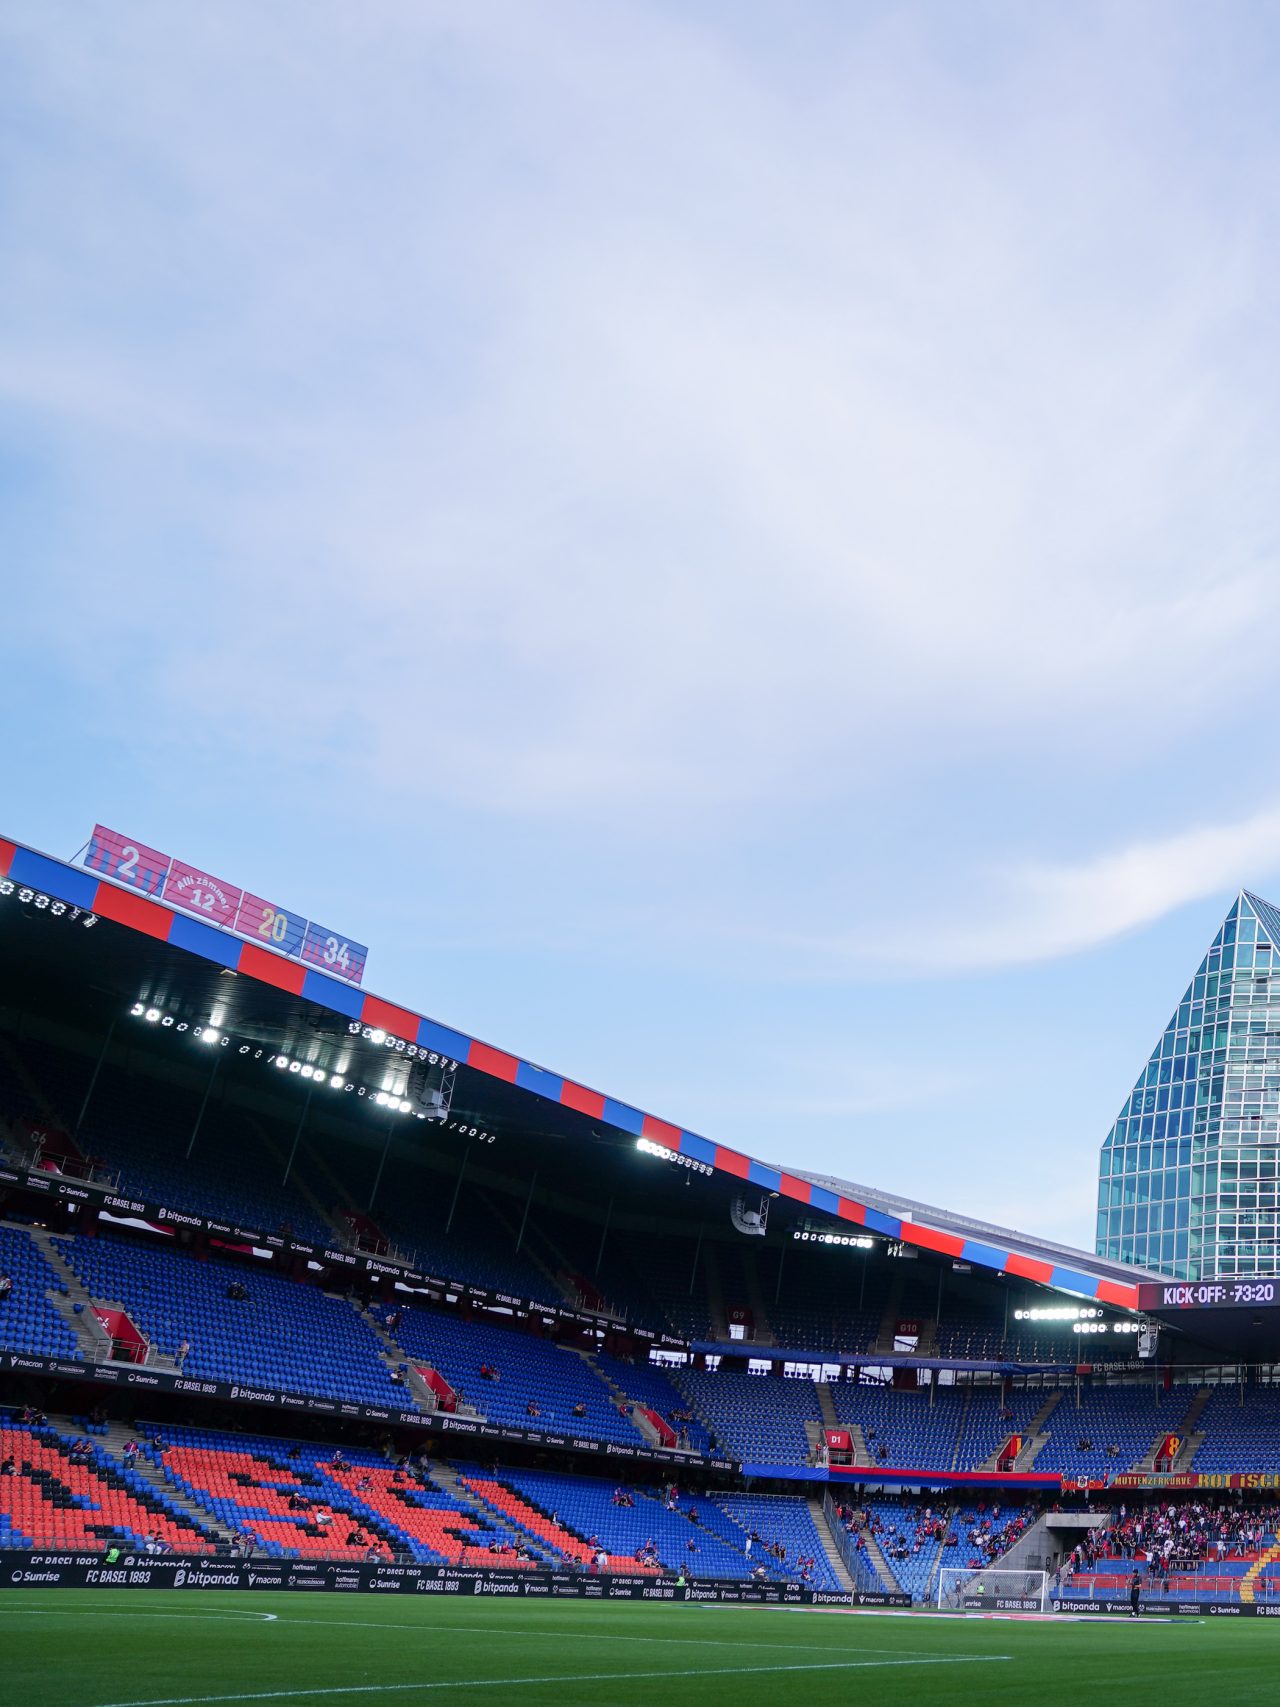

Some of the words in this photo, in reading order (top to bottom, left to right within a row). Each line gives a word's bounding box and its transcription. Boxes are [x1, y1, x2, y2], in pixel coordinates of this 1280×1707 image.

[117, 846, 141, 879] 2
[177, 875, 195, 890] Alli
[190, 888, 216, 912] 12
[258, 908, 288, 942] 20
[323, 937, 350, 971] 34
[66, 1187, 89, 1199] Sunrise
[103, 1196, 113, 1205] FC
[112, 1198, 130, 1210] BASEL
[130, 1202, 145, 1213] 1893
[166, 1211, 202, 1227] bitpanda
[213, 1223, 231, 1233] macron
[372, 1262, 400, 1276] bitpanda
[1163, 1286, 1226, 1304] KICK-OFF:
[1229, 1284, 1274, 1302] -73:20
[534, 1304, 557, 1315] bitpanda
[17, 1359, 44, 1369] macron
[1104, 1362, 1126, 1372] BASEL
[135, 1375, 159, 1385] Sunrise
[174, 1379, 183, 1389] FC
[183, 1380, 200, 1392] BASEL
[199, 1382, 217, 1394] 1893
[239, 1389, 275, 1402] bitpanda
[286, 1397, 304, 1406] macron
[371, 1410, 389, 1419] Sunrise
[449, 1420, 477, 1432] bitpanda
[831, 1436, 841, 1444] D1
[612, 1445, 634, 1456] bitpanda
[1168, 1437, 1180, 1456] 8
[1115, 1476, 1191, 1485] MUTTENZERKURVE
[1198, 1473, 1233, 1488] ROT
[23, 1571, 60, 1582] Sunrise
[85, 1570, 100, 1583] FC
[100, 1570, 127, 1583] BASEL
[129, 1571, 151, 1584] 1893
[187, 1572, 240, 1588] bitpanda
[255, 1576, 282, 1585] macron
[377, 1580, 401, 1589] Sunrise
[416, 1580, 425, 1590] FC
[425, 1580, 444, 1591] BASEL
[445, 1581, 460, 1592] 1893
[482, 1583, 519, 1595] bitpanda
[691, 1589, 717, 1599] bitpanda
[818, 1594, 852, 1604] bitpanda
[1062, 1601, 1100, 1612] bitpanda
[1217, 1606, 1240, 1614] Sunrise
[1256, 1606, 1266, 1615] FC
